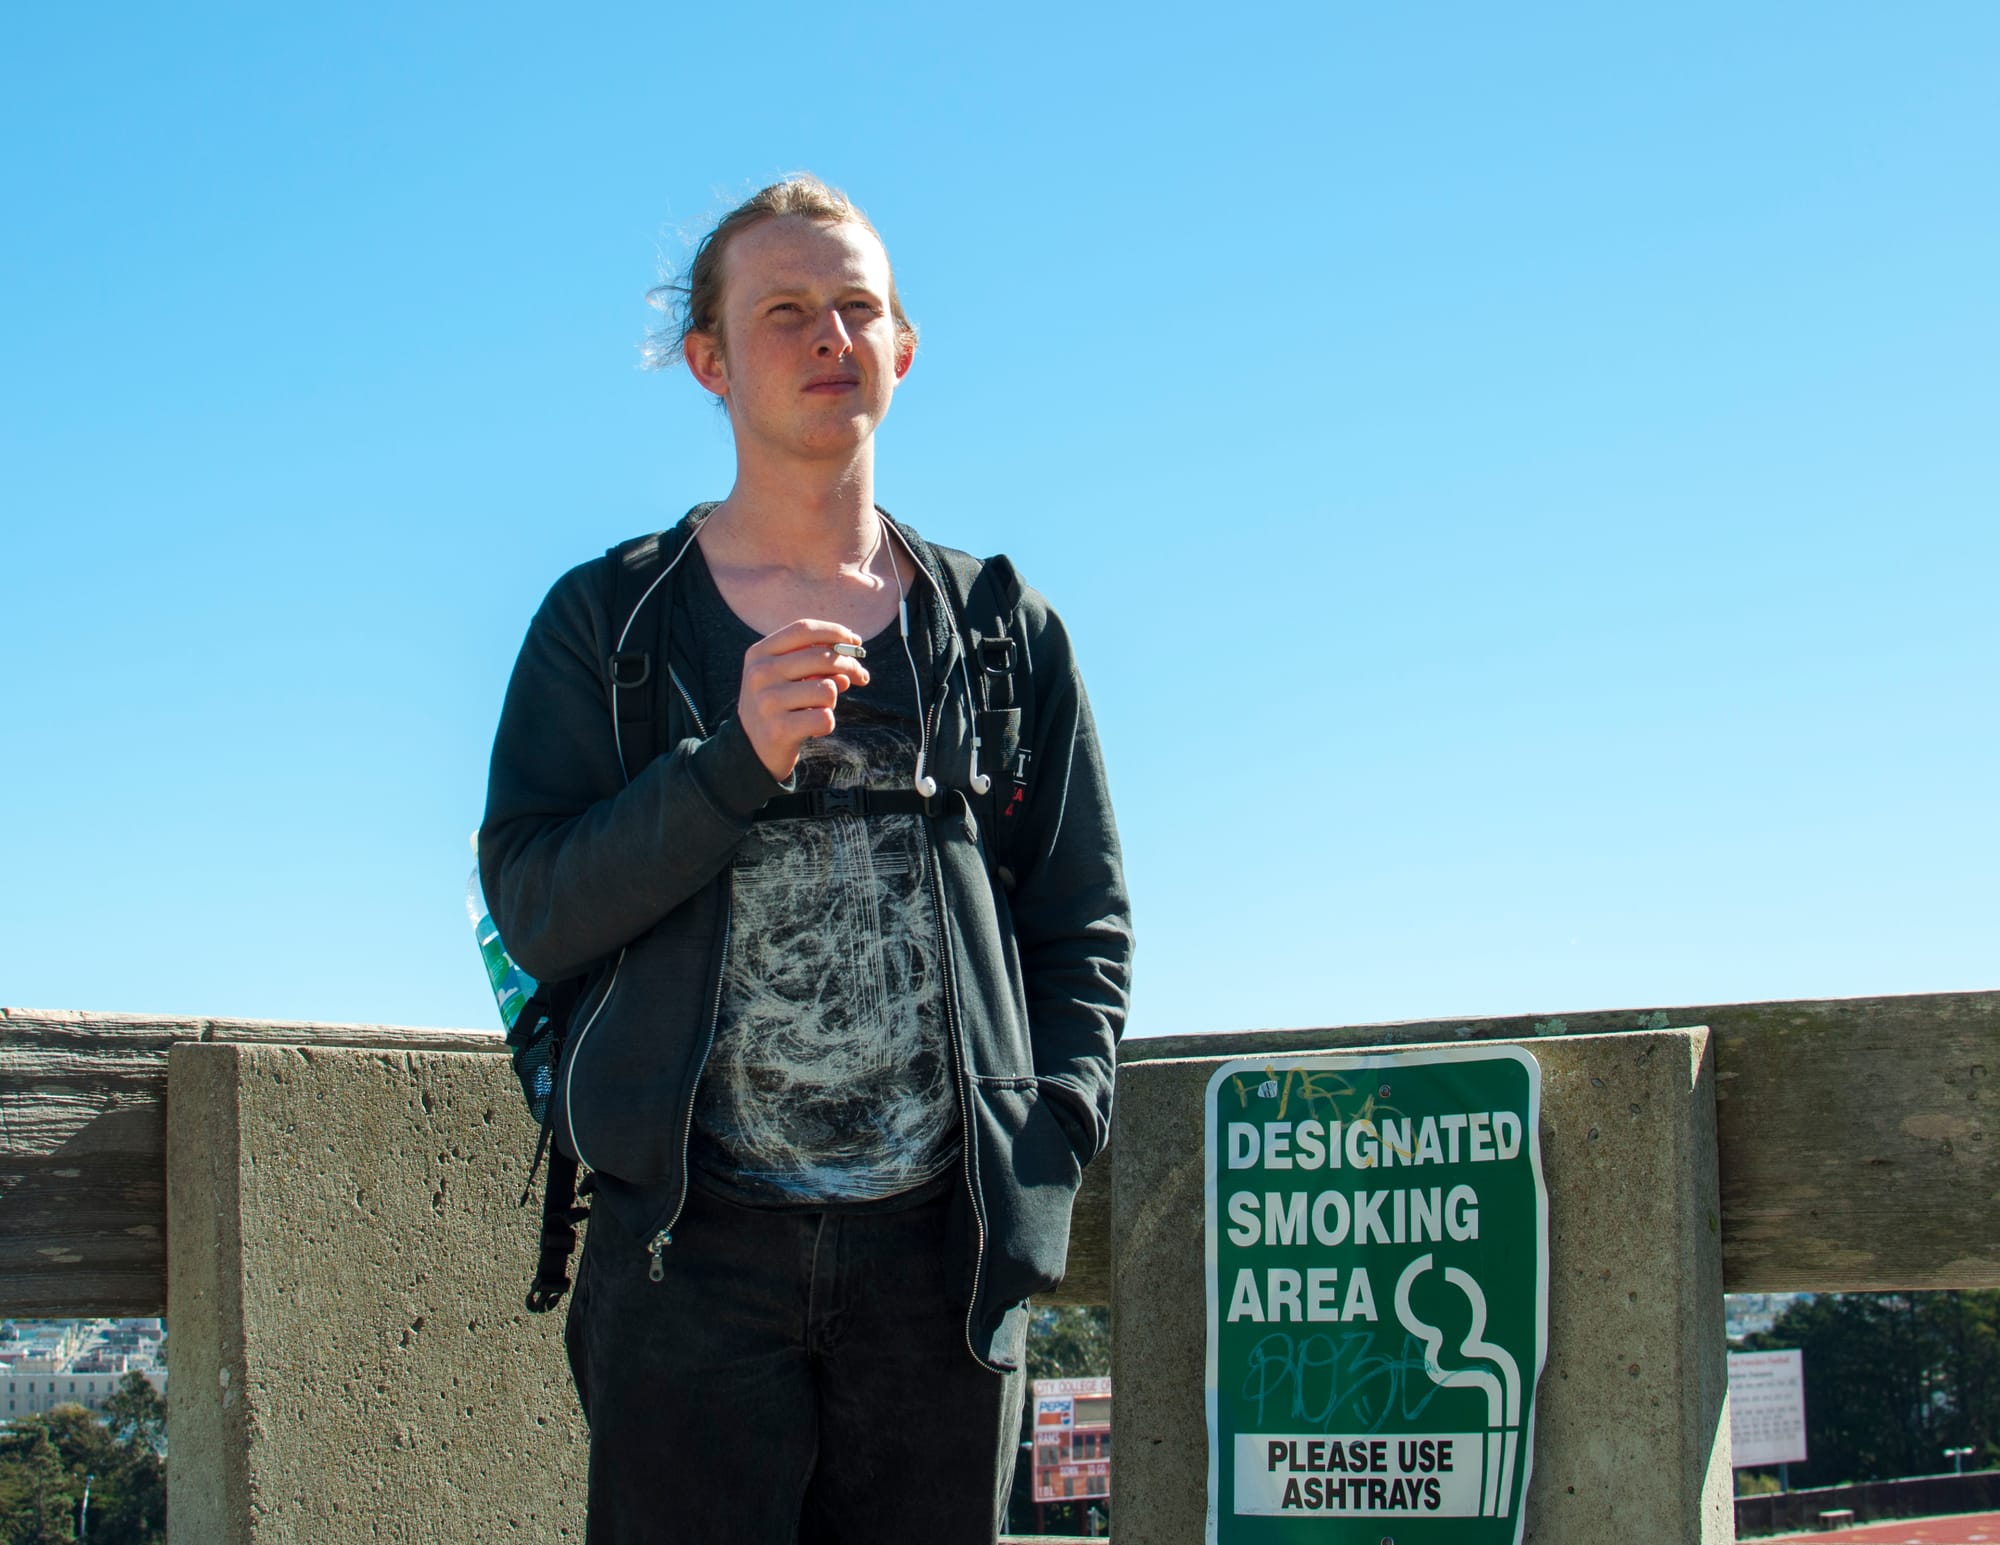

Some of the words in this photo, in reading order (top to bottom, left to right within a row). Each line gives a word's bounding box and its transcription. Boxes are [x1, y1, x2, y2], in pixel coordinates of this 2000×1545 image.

[1228, 1111, 1522, 1170] DESIGNATED
[1227, 1185, 1479, 1246] SMOKING
[1227, 1268, 1379, 1322] AREA
[1036, 1382, 1055, 1393] CITY
[1060, 1380, 1096, 1392] COLLEGE
[1040, 1401, 1071, 1412] PEPSI
[1269, 1440, 1388, 1472] PLEASE
[1399, 1440, 1453, 1472] USE
[1282, 1477, 1441, 1510] ASHTRAYS
